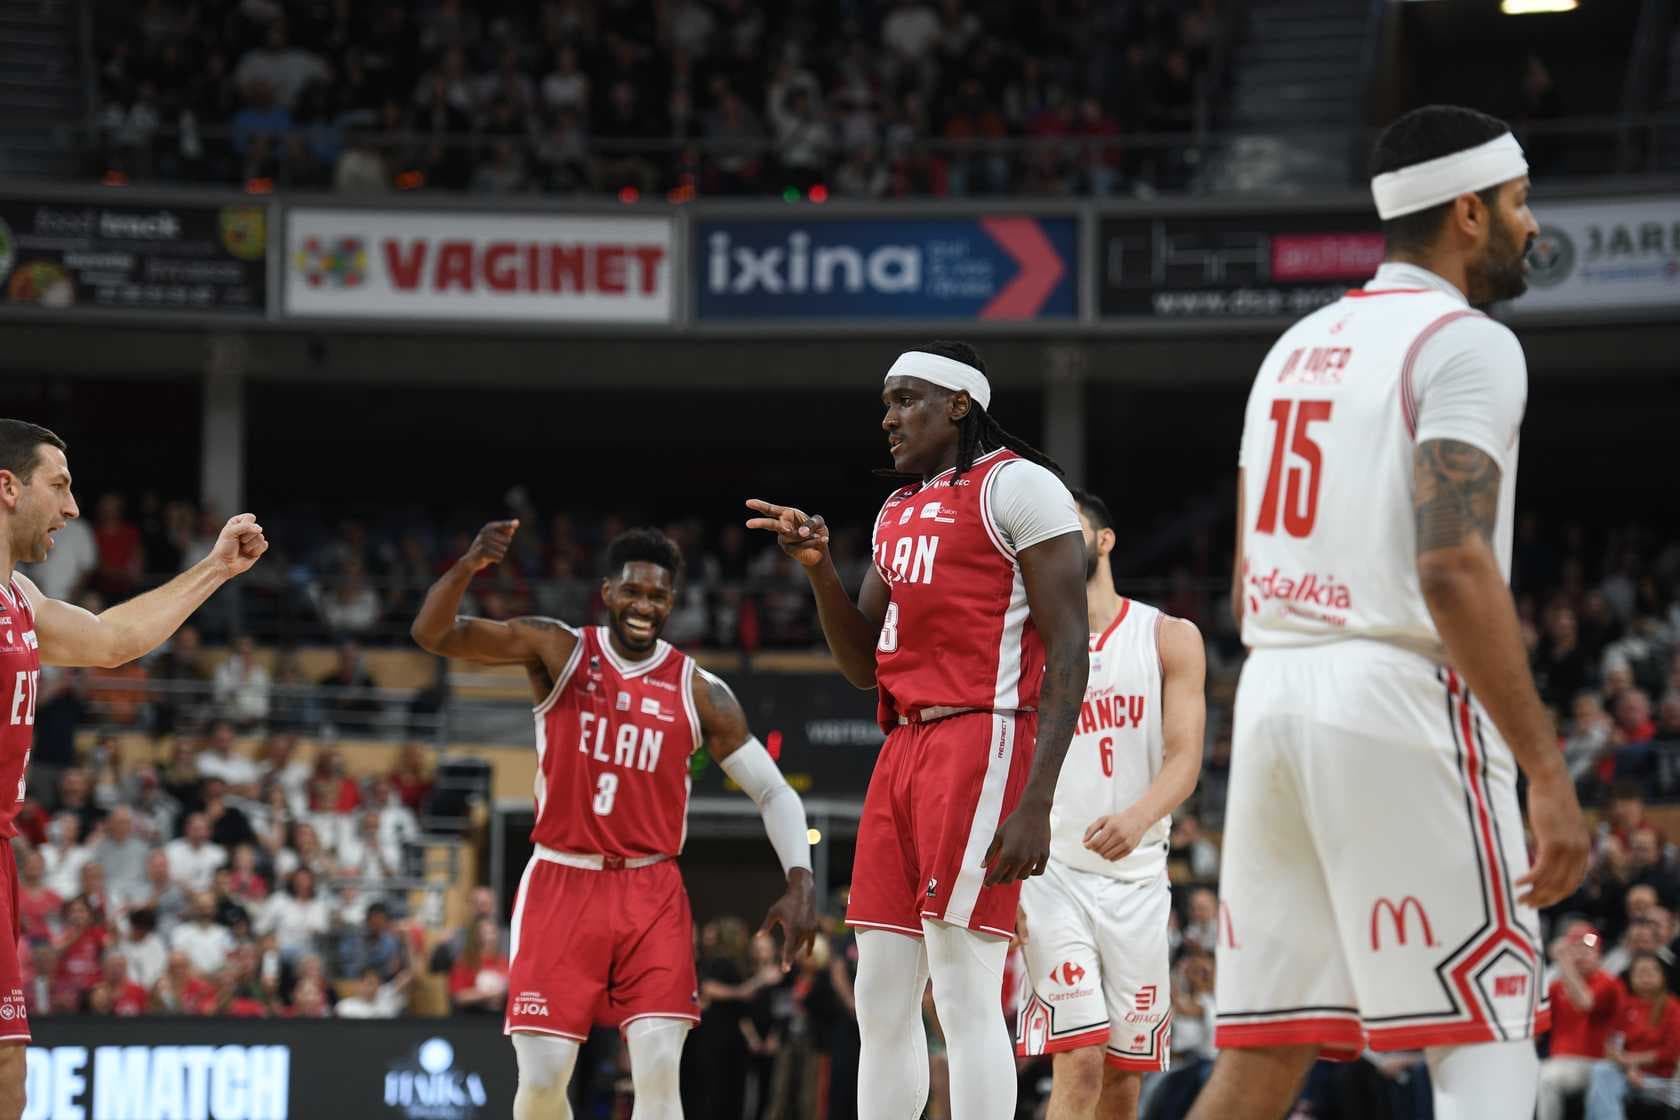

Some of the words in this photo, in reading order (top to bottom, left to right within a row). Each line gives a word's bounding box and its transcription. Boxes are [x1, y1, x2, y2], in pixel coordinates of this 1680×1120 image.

[381, 237, 665, 297] VAGINET
[708, 230, 922, 294] ixina
[1255, 398, 1333, 540] 15
[873, 535, 940, 585] LAN
[1261, 569, 1352, 609] dalkia
[10, 670, 39, 725] EL
[578, 710, 664, 773] ELAN
[1098, 736, 1114, 778] 6
[592, 771, 619, 816] 3
[520, 1003, 549, 1017] JOA
[1048, 988, 1095, 1002] Carrefour
[25, 1045, 86, 1120] DE
[94, 1045, 290, 1120] MATCH
